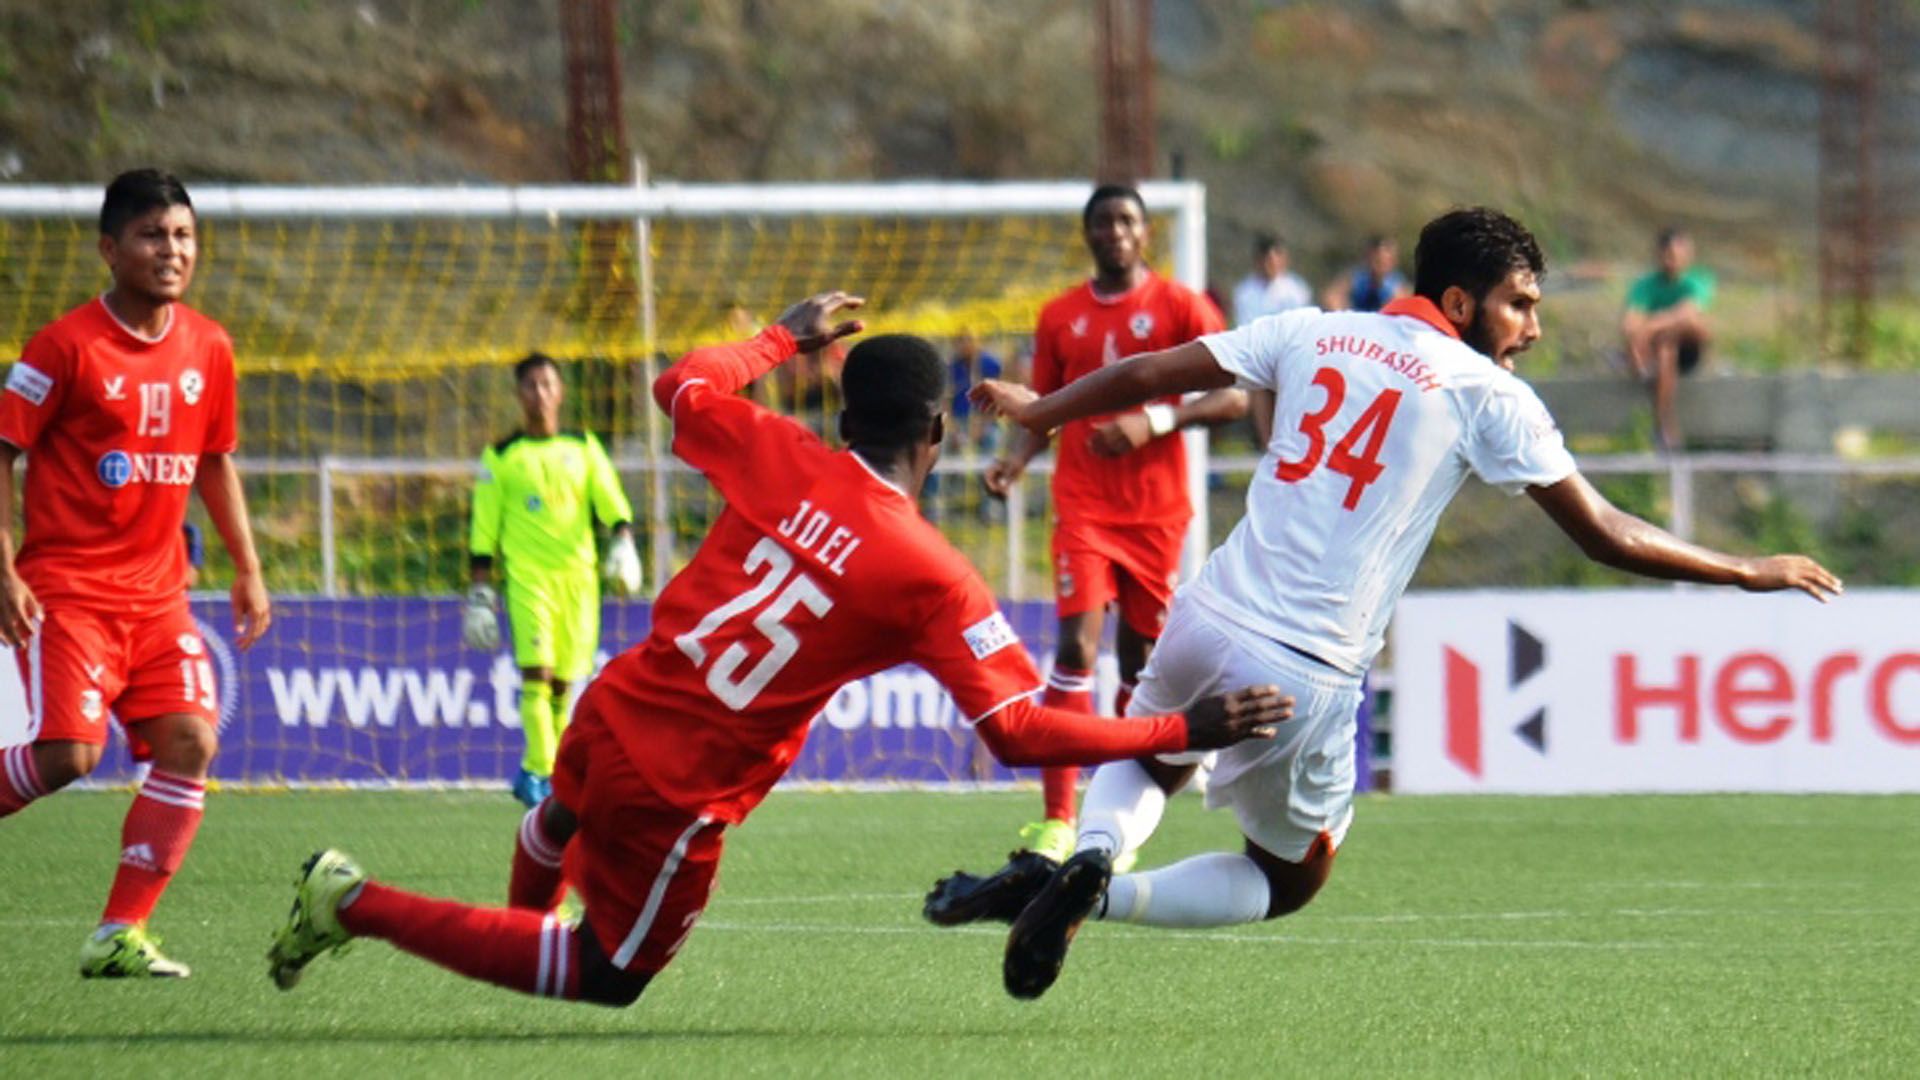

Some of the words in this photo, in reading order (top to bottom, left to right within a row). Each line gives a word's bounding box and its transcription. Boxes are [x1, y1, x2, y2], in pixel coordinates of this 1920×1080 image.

[1315, 335, 1442, 393] SHUBASISH
[137, 382, 171, 436] 19
[1274, 366, 1403, 512] 34
[131, 454, 199, 485] NECS
[777, 500, 861, 577] JOEL
[673, 536, 835, 712] 25
[266, 653, 524, 729] www.t
